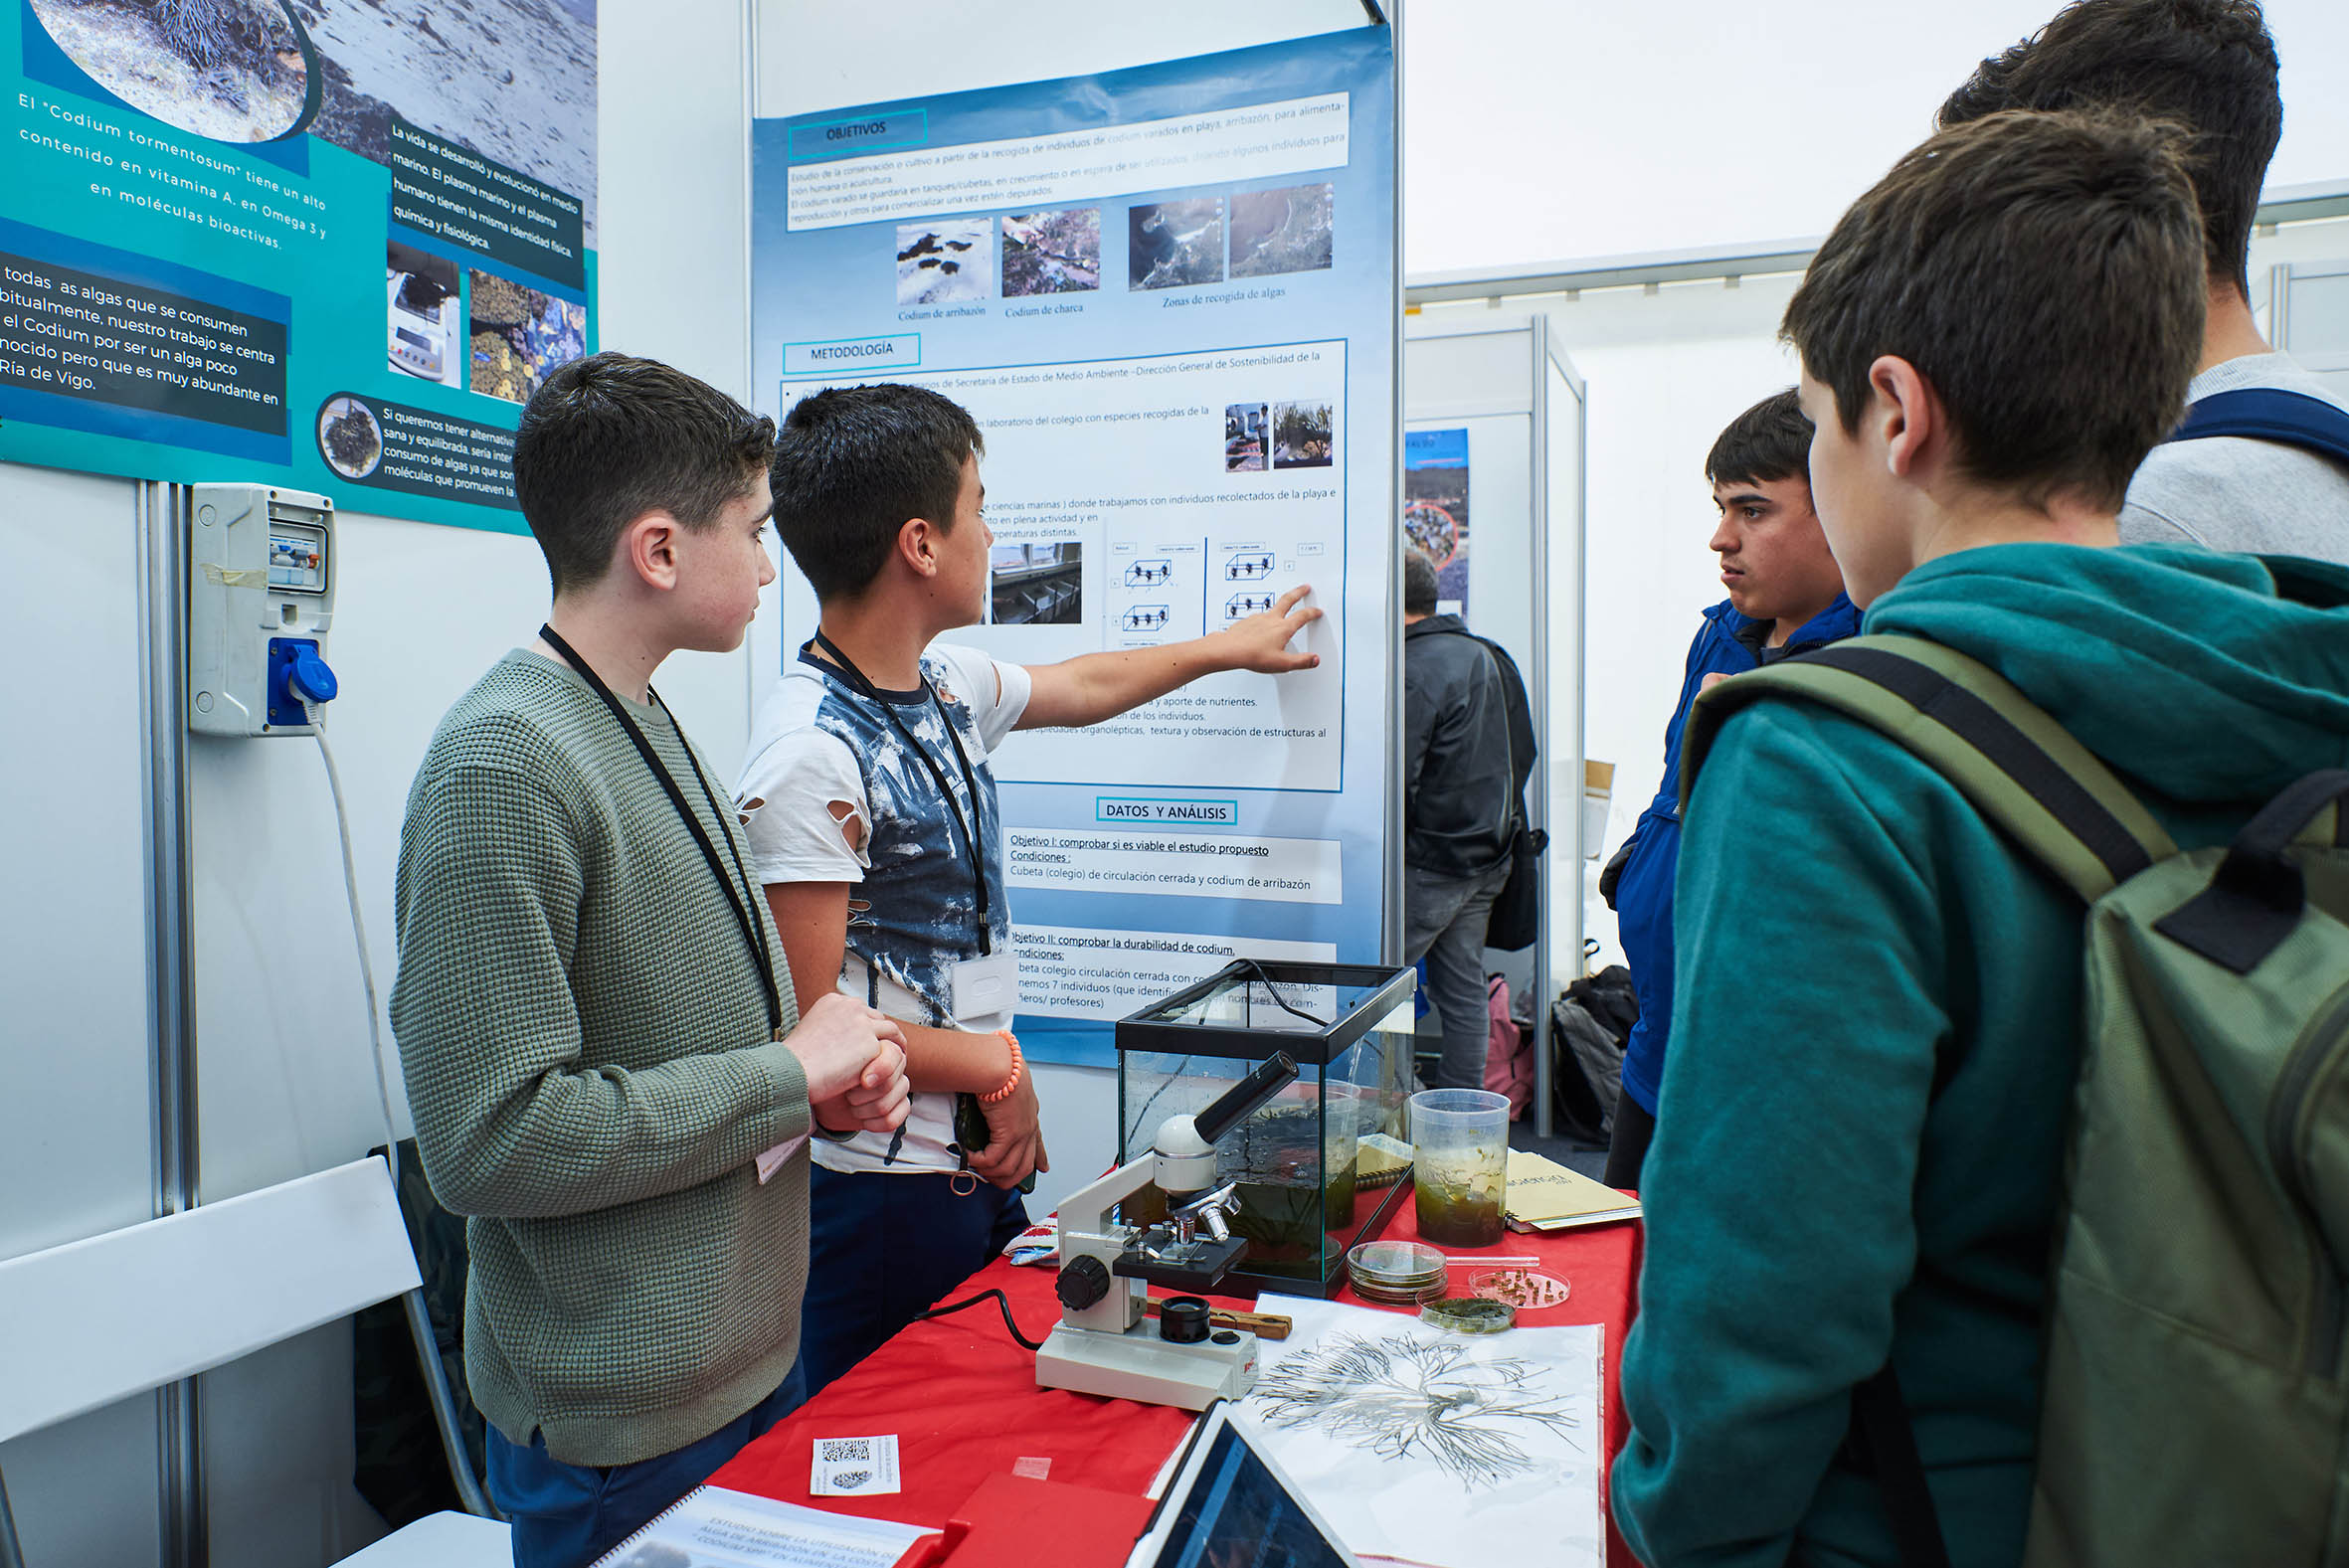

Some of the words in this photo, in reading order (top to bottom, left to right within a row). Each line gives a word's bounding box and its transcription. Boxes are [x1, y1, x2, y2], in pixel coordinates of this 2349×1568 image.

[826, 121, 886, 141] OBJETIVOS
[19, 93, 34, 109] El
[247, 170, 278, 192] tiene
[283, 186, 298, 200] un
[303, 194, 325, 211] alto
[20, 128, 112, 166] contenido
[121, 160, 141, 175] en
[149, 168, 217, 199] vitamina
[242, 200, 257, 213] en
[263, 205, 305, 231] Omega
[310, 222, 316, 235] 3
[90, 183, 110, 198] en
[120, 191, 203, 224] moléculas
[5, 266, 51, 289] todas
[82, 286, 122, 306] algas
[126, 298, 156, 314] que
[160, 305, 176, 318] se
[180, 310, 247, 337] consumen
[1164, 297, 1189, 308] Zonas
[1192, 294, 1202, 305] de
[1205, 290, 1244, 304] recogida
[1247, 289, 1258, 300] de
[1261, 287, 1285, 300] algas
[898, 310, 931, 320] Codium
[933, 308, 943, 319] de
[946, 305, 986, 318] arribazón
[1005, 306, 1039, 318] Codium
[1041, 304, 1052, 315] de
[1054, 303, 1083, 314] charca
[4, 314, 17, 328] el
[24, 317, 89, 344] Codium
[94, 335, 119, 350] por
[124, 341, 146, 355] ser
[151, 346, 169, 360] un
[174, 350, 202, 369] alga
[207, 359, 237, 376] poco
[108, 315, 165, 338] nuestro
[170, 328, 216, 351] trabajo
[220, 341, 233, 355] se
[237, 346, 274, 365] centra
[811, 341, 894, 360] METODOLOGÍA
[0, 338, 57, 359] nocido
[63, 351, 98, 368] pero
[102, 359, 132, 375] que
[136, 366, 152, 379] es
[157, 370, 188, 388] muy
[192, 376, 261, 402] abundante
[264, 393, 277, 406] en
[0, 359, 25, 377] Ría
[31, 365, 52, 382] de
[57, 369, 95, 390] Vigo.
[1163, 697, 1193, 708] aporte
[1194, 696, 1207, 706] de
[1209, 698, 1257, 707] nutrientes.
[1151, 726, 1181, 736] textura
[1192, 726, 1246, 737] observación
[1250, 727, 1261, 737] de
[1264, 728, 1315, 738] estructuras
[1319, 728, 1326, 738] al
[1107, 804, 1149, 817] DATOS
[1157, 805, 1165, 817] Y
[1168, 803, 1226, 820] ANÁLISIS
[1010, 834, 1050, 848] Objetivo
[1058, 838, 1111, 851] comprobar
[1112, 839, 1121, 850] si
[1122, 841, 1134, 851] es
[1135, 840, 1166, 852] viable
[1167, 841, 1176, 852] el
[1178, 842, 1216, 855] estudio
[1218, 845, 1269, 858] propuesto
[1010, 851, 1065, 862] Condiciones
[1010, 865, 1043, 877] Cubeta
[1046, 866, 1085, 881] (colegio)
[1088, 869, 1100, 880] de
[1103, 871, 1156, 882] circulación
[1159, 873, 1195, 884] cerrada
[1207, 875, 1244, 886] codium
[1247, 876, 1260, 888] de
[1263, 877, 1310, 890] arribazón
[1058, 937, 1110, 949] comprobar
[1113, 938, 1121, 949] la
[1124, 939, 1178, 953] durabilidad
[1181, 942, 1193, 955] de
[1019, 961, 1039, 973] beta
[1042, 964, 1076, 978] colegio
[1079, 966, 1130, 979] circulación
[1134, 971, 1170, 982] cerrada
[1173, 974, 1190, 983] con
[1018, 980, 1049, 990] nemos
[1053, 979, 1058, 990] 7
[1061, 979, 1110, 993] individuos
[1113, 983, 1135, 996] (que
[1050, 995, 1104, 1009] profesores)
